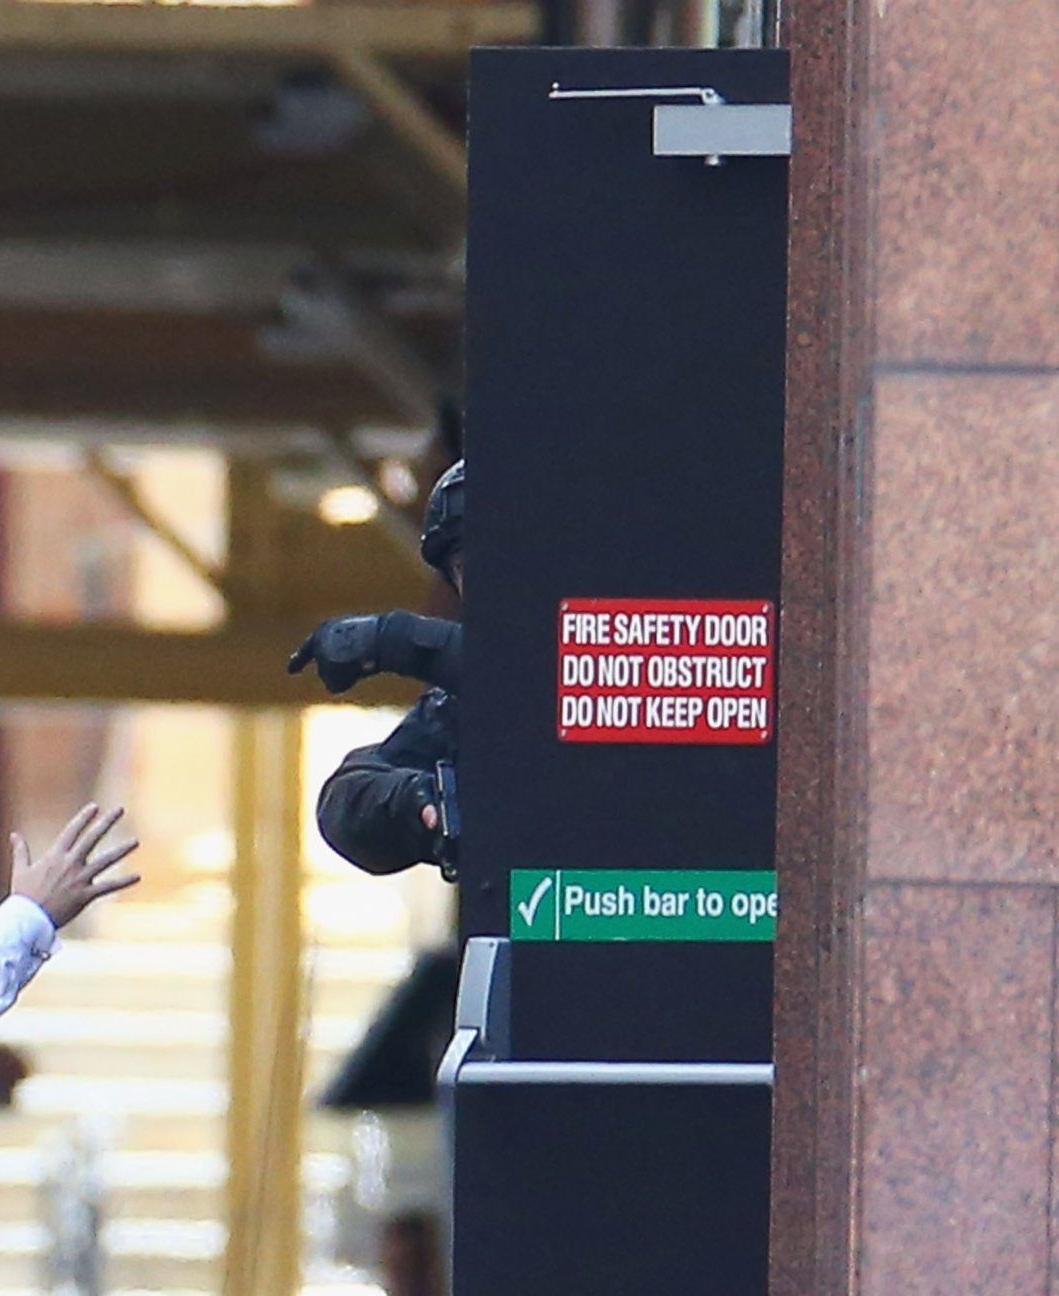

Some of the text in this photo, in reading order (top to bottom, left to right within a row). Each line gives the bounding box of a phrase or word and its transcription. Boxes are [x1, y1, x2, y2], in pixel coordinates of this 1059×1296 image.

[562, 614, 767, 646] FIRE SAFETY DOOR
[563, 655, 765, 688] DO NOT OBSTRUCT
[562, 697, 766, 729] DO NOT KEEP OPEN
[565, 886, 634, 916] Push
[644, 884, 687, 916] bar
[696, 887, 723, 916] to
